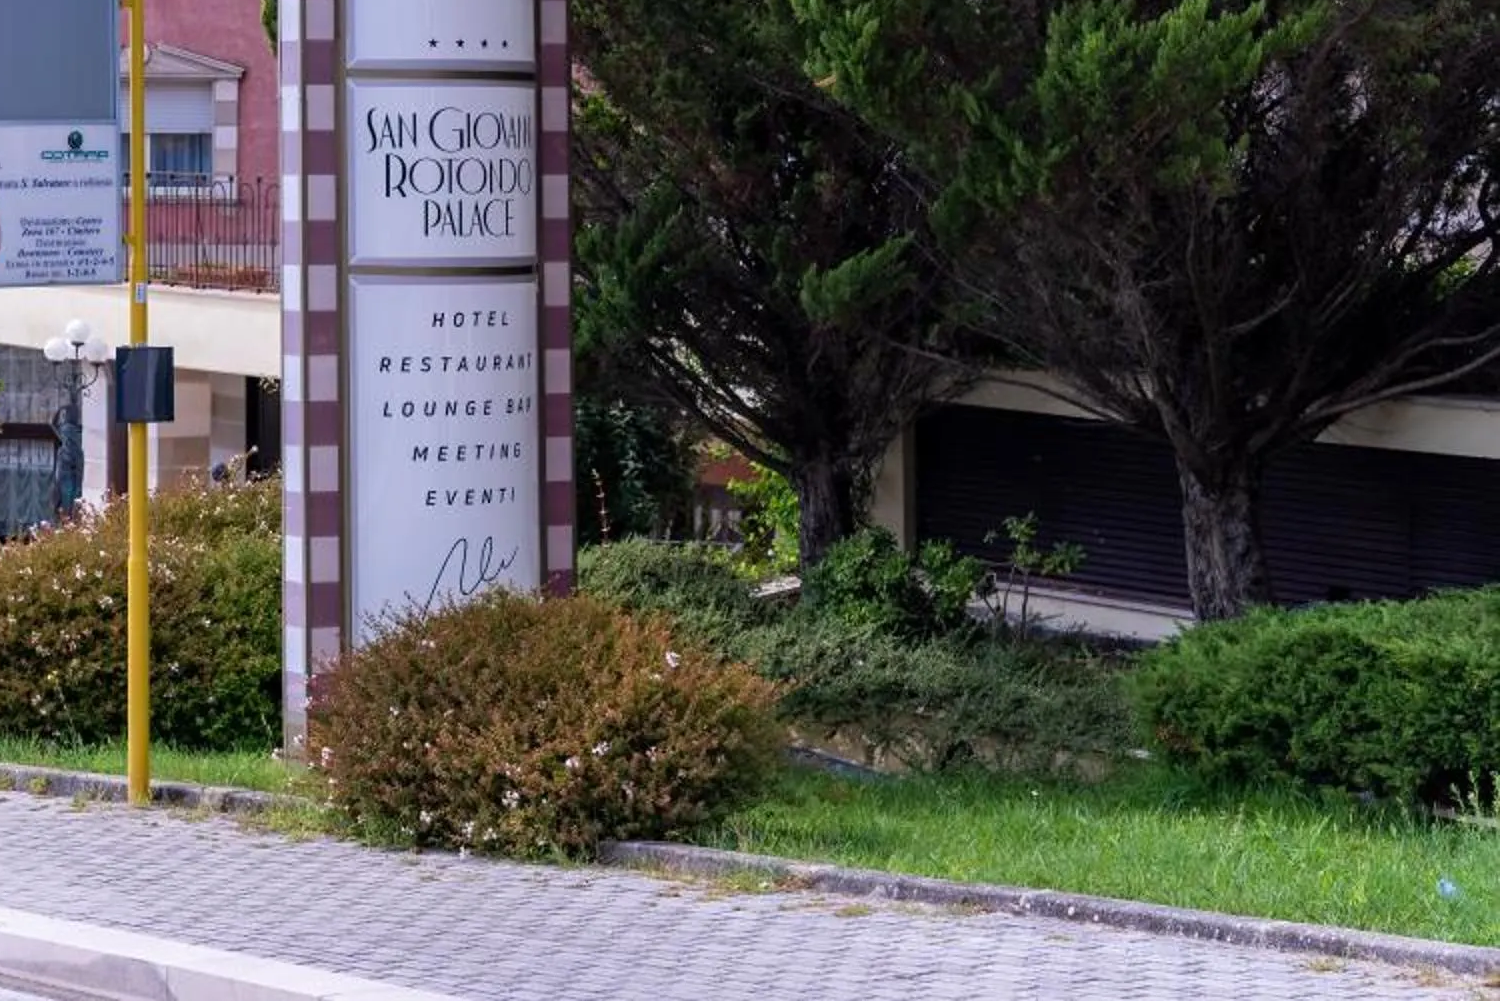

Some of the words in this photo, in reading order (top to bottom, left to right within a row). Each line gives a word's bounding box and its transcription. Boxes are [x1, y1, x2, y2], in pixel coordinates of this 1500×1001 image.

[366, 106, 417, 154] SAN
[428, 105, 533, 154] GIOVAN
[384, 152, 533, 199] ROTONDO
[423, 198, 516, 238] PALACE
[431, 310, 510, 329] HOTEL
[379, 351, 532, 374] RESTAURANT
[382, 400, 493, 418] LOUNGE
[412, 442, 522, 463] MEETING
[425, 487, 516, 507] EVENTI
